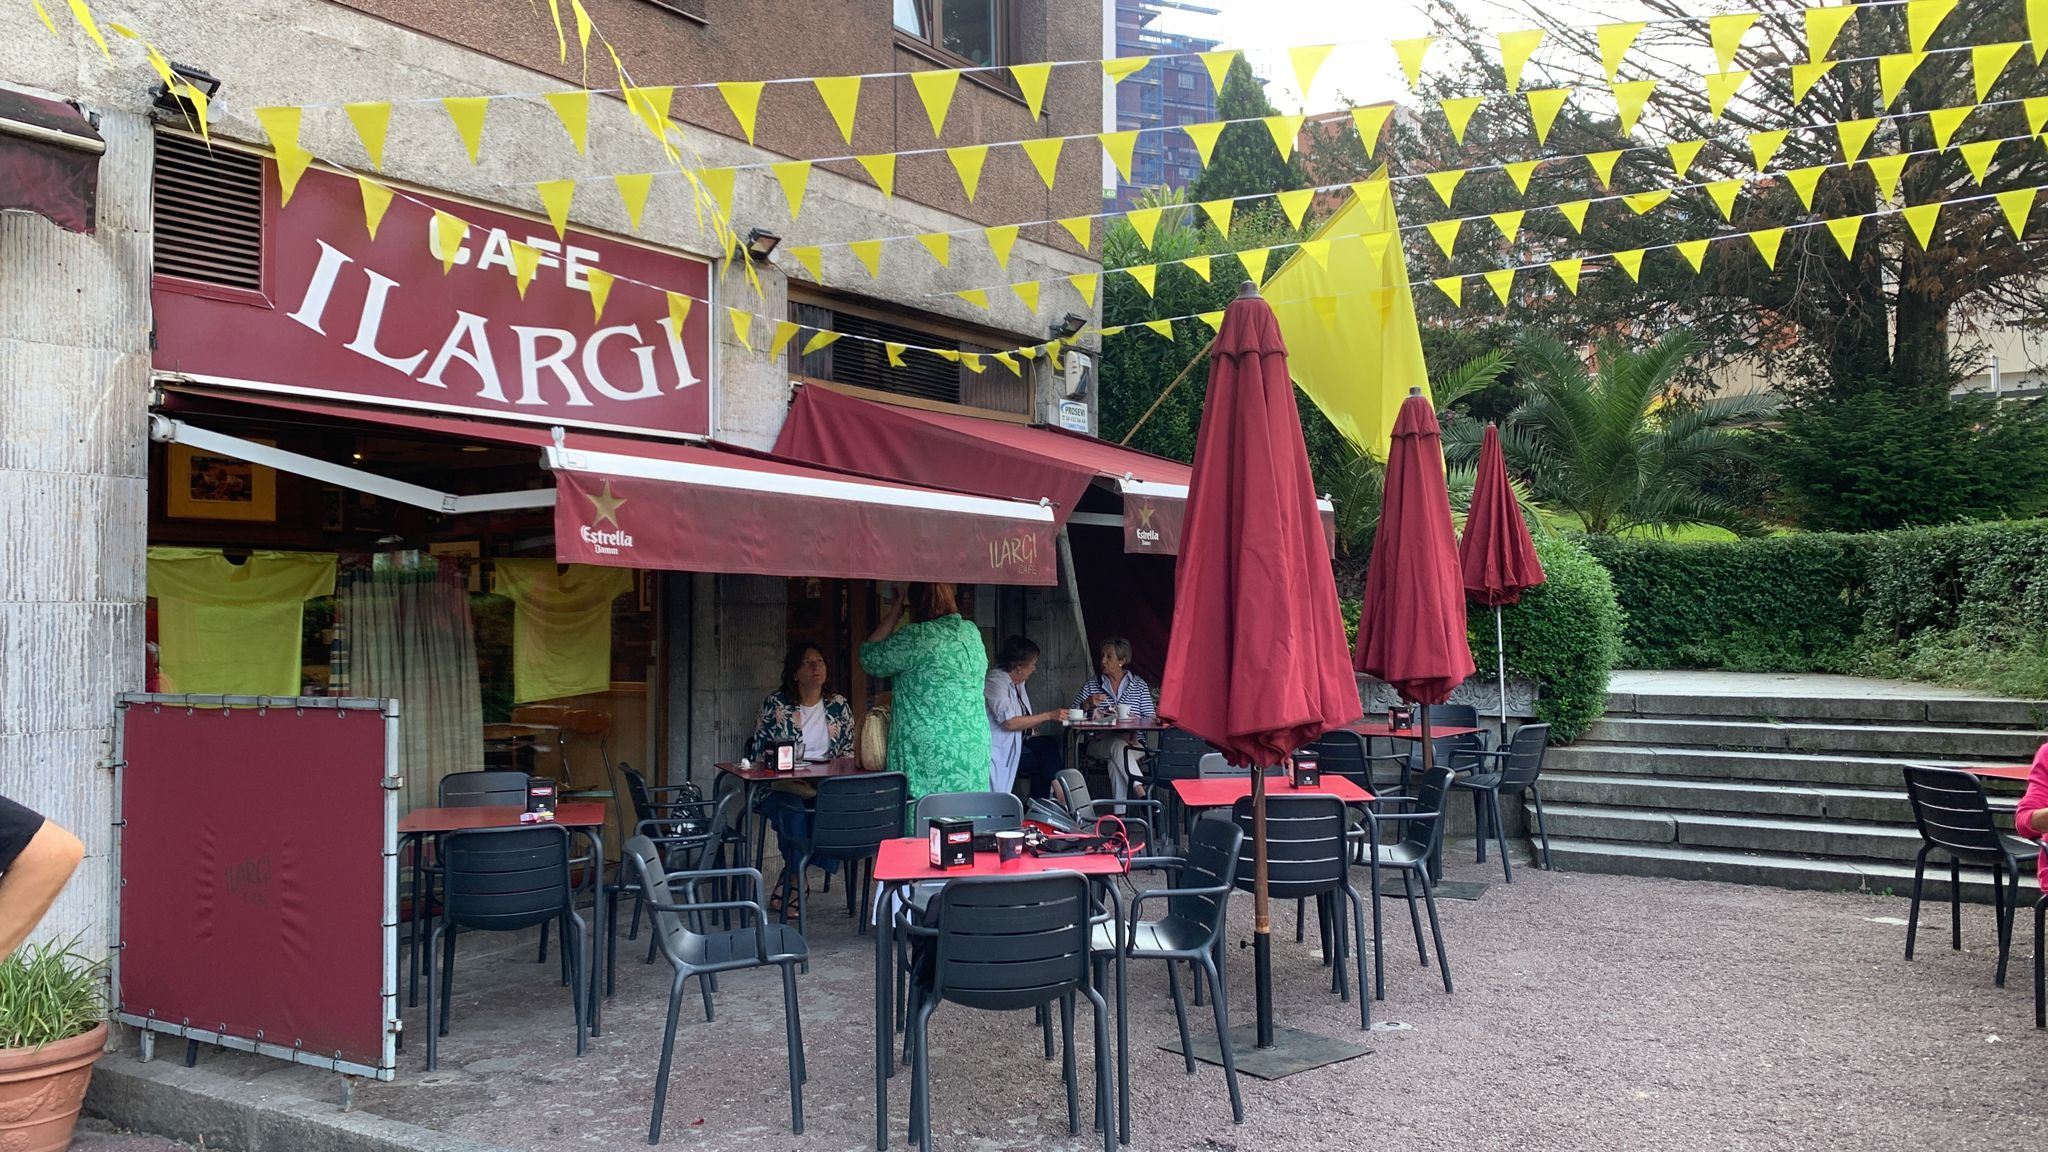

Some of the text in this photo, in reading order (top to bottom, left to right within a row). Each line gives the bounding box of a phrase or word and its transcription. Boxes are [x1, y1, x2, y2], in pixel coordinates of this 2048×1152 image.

[429, 214, 600, 291] CAFE
[286, 238, 701, 406] ILARGI
[580, 525, 634, 547] Estrella
[594, 544, 619, 555] Damm
[989, 532, 1037, 568] ILARGI
[224, 854, 272, 894] ILARGI
